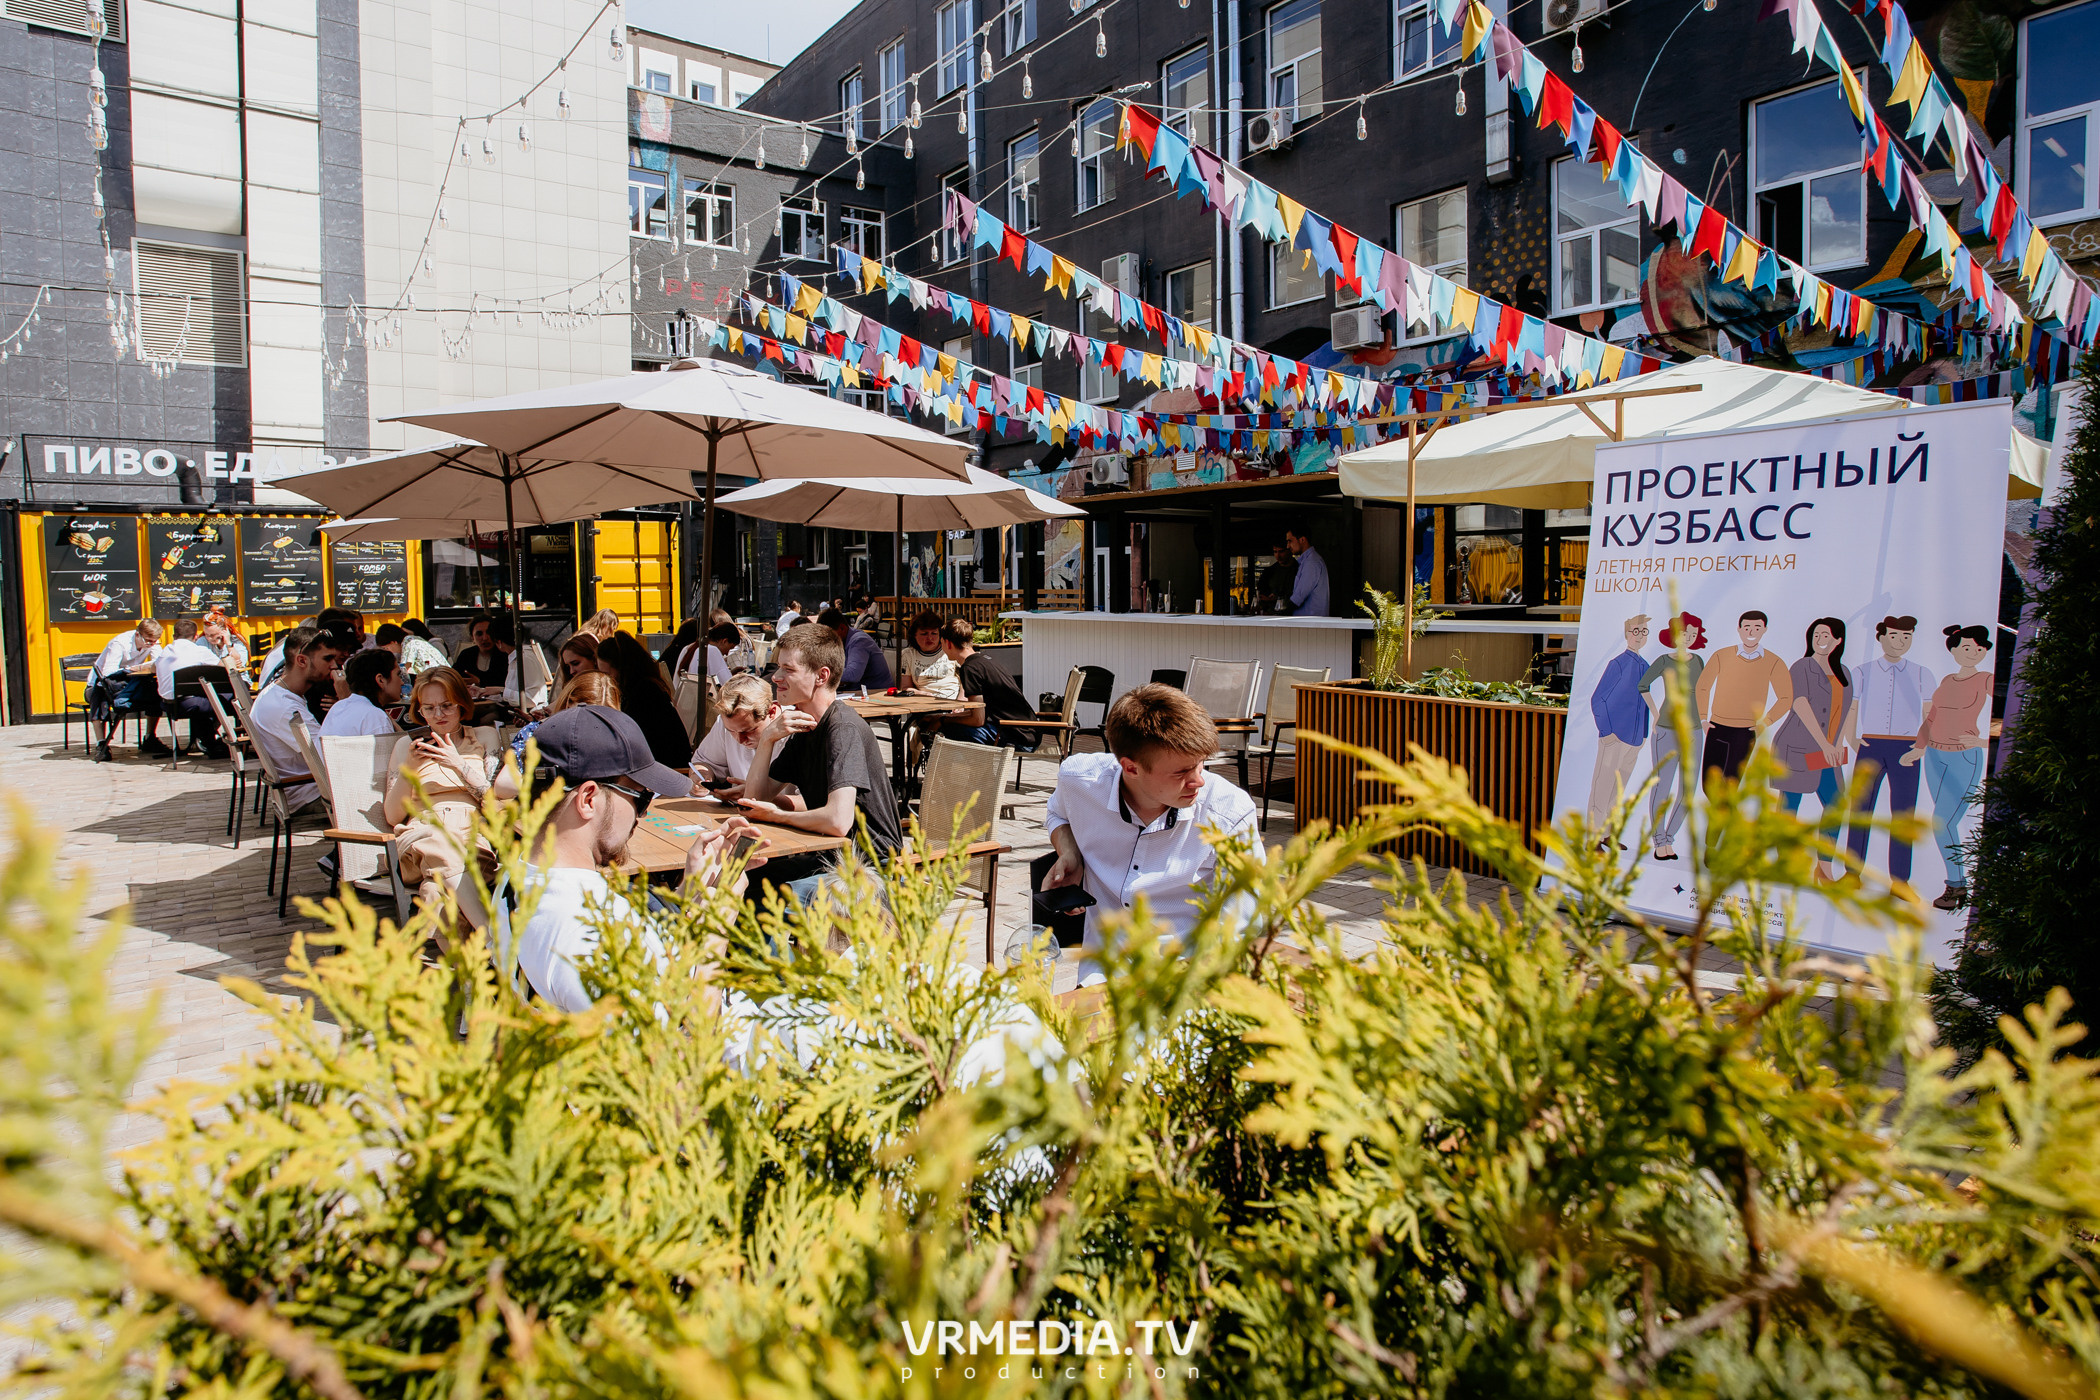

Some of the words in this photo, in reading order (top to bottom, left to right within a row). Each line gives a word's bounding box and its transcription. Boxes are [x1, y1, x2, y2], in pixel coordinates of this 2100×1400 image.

[43, 445, 177, 477] ПИВО
[1605, 431, 1929, 505] ПРОЕКТНЫЙ
[948, 530, 965, 540] БАР
[1601, 502, 1815, 548] КУЗБАСС
[1595, 557, 1666, 575] ЛЕТНЯЯ
[1671, 553, 1797, 573] ПРОЕКТНАЯ
[83, 573, 108, 582] WOK
[1594, 577, 1663, 593] ШКОЛА
